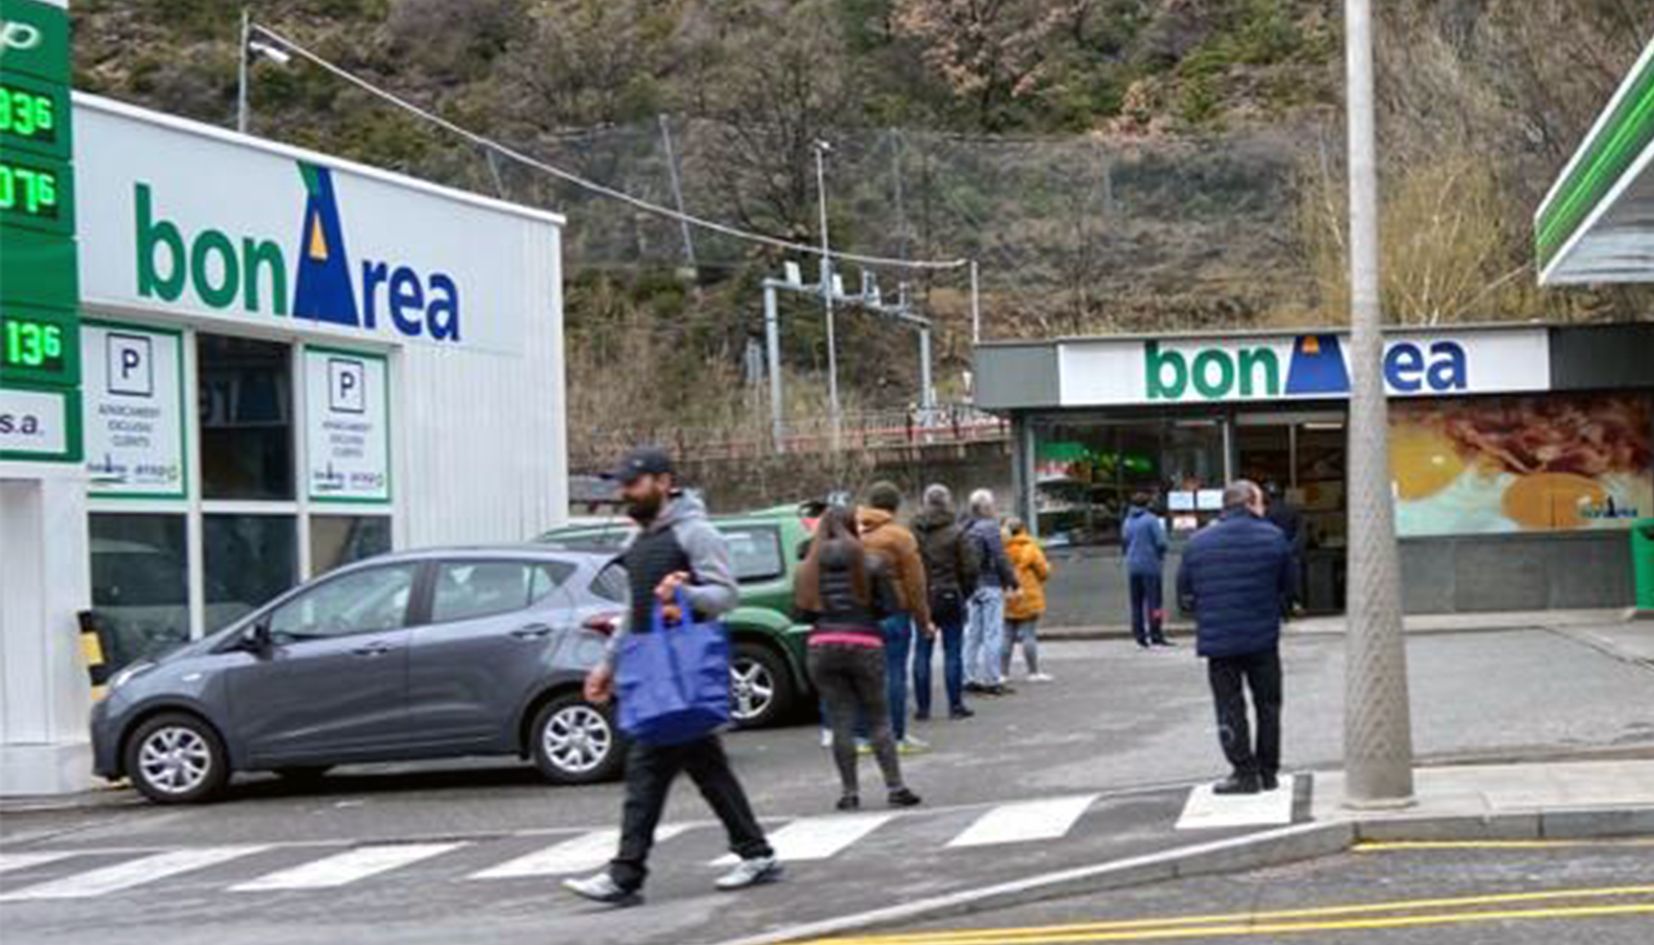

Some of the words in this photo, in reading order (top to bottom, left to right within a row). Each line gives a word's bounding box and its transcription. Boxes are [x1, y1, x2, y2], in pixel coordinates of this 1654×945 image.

[134, 160, 460, 342] bonArea
[7, 321, 60, 365] 136
[121, 349, 140, 379] P
[339, 371, 355, 398] P
[1143, 335, 1468, 399] bonAea
